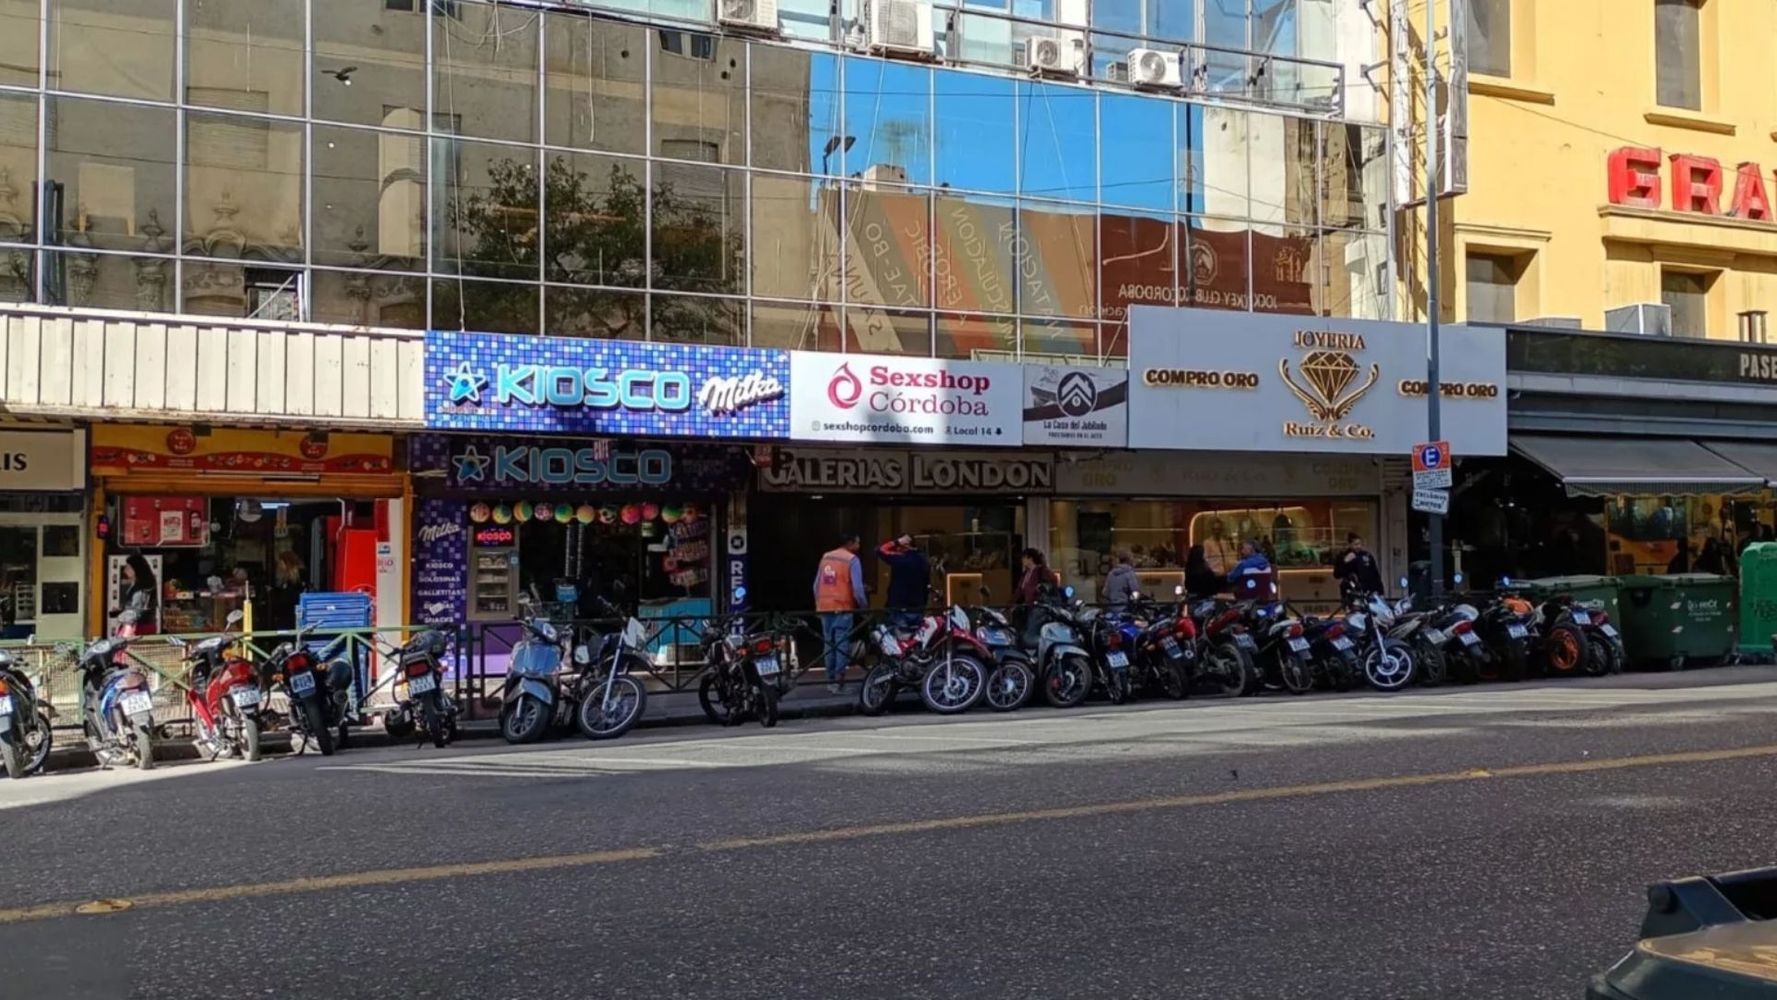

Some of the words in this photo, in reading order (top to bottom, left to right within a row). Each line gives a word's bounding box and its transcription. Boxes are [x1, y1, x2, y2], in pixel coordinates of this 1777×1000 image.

[1607, 146, 1777, 224] GRA
[1293, 329, 1366, 351] JOYERIA
[498, 363, 691, 411] KIOSCO
[698, 369, 784, 414] Milka
[869, 365, 990, 394] Sexshop
[1145, 368, 1219, 387] COMPRO
[1223, 371, 1259, 388] ORO
[1467, 382, 1499, 399] ORO
[869, 391, 989, 416] Córdoba
[823, 421, 934, 435] sexshopcordoba.com
[953, 426, 976, 436] Local
[978, 426, 992, 436] 14
[1283, 420, 1325, 437] Ruiz
[1328, 422, 1342, 438] &
[1346, 422, 1375, 439] Co.
[0, 453, 27, 471] IS
[495, 446, 671, 484] KIOSCO
[1425, 448, 1437, 466] E
[765, 449, 903, 488] GALERIAS
[913, 454, 1053, 488] LONDON
[418, 521, 461, 542] Milka
